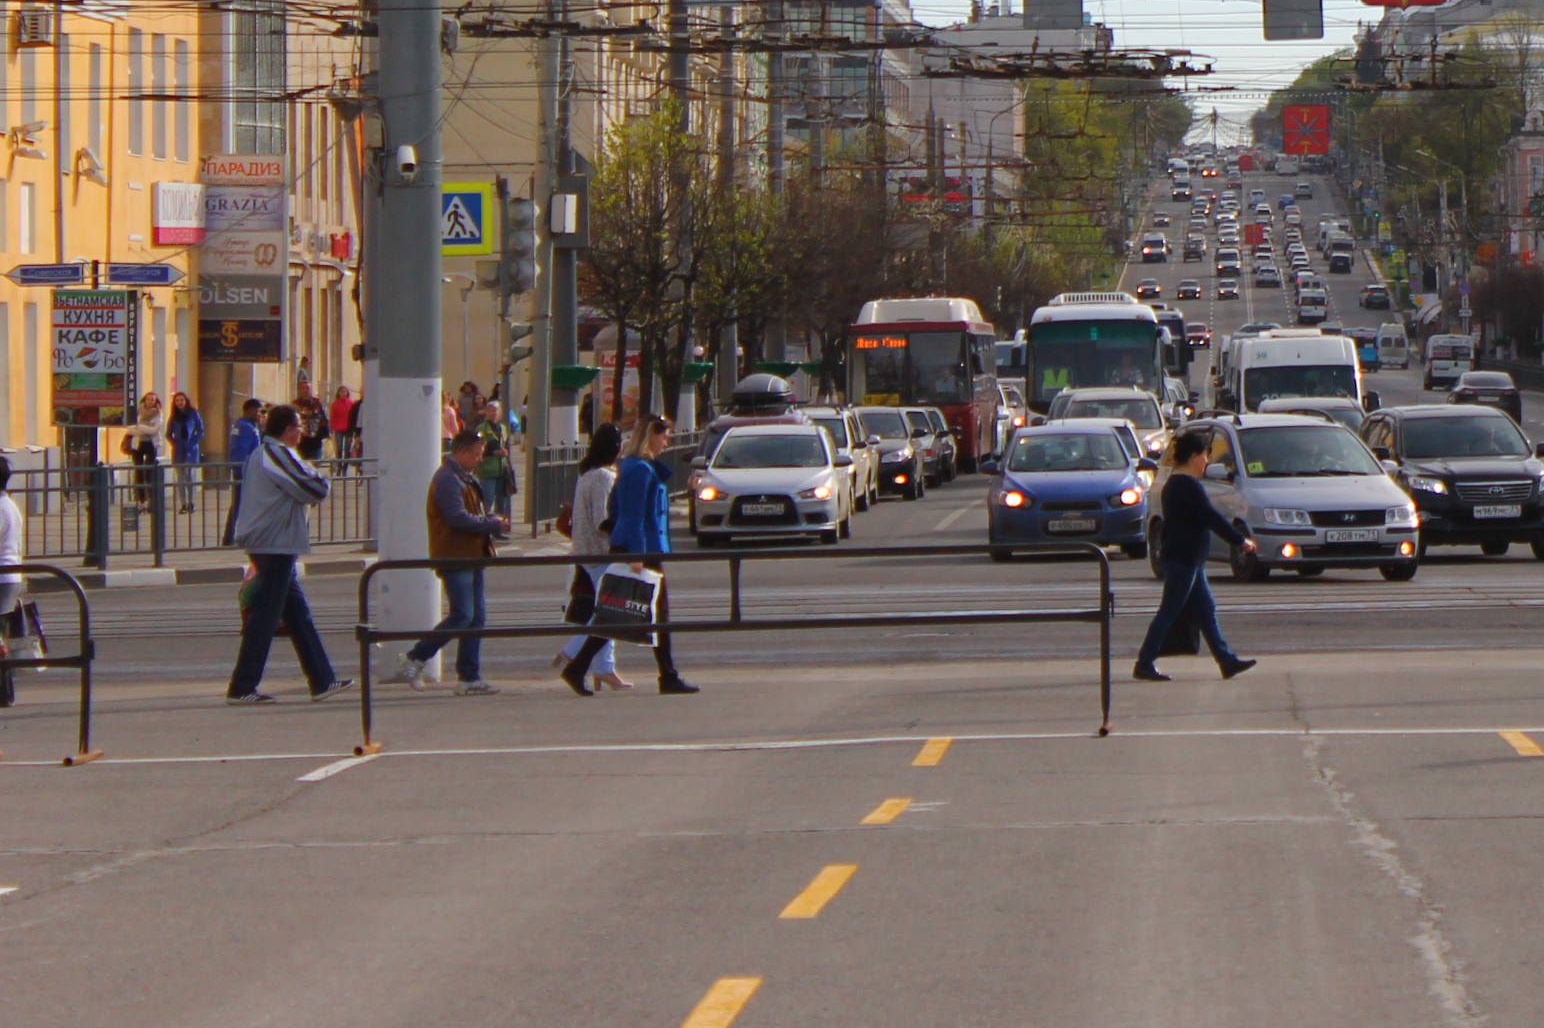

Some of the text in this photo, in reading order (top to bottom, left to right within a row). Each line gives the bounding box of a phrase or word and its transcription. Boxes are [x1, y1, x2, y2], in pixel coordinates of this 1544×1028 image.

[207, 162, 281, 177] ПАРАДИЗ
[205, 199, 269, 211] GRAZIA
[54, 297, 125, 307] ВЬЕТНАМСКАЯ
[199, 287, 268, 304] OLSEN
[63, 310, 115, 325] КУХНЯ
[58, 329, 119, 345] КАФЕ
